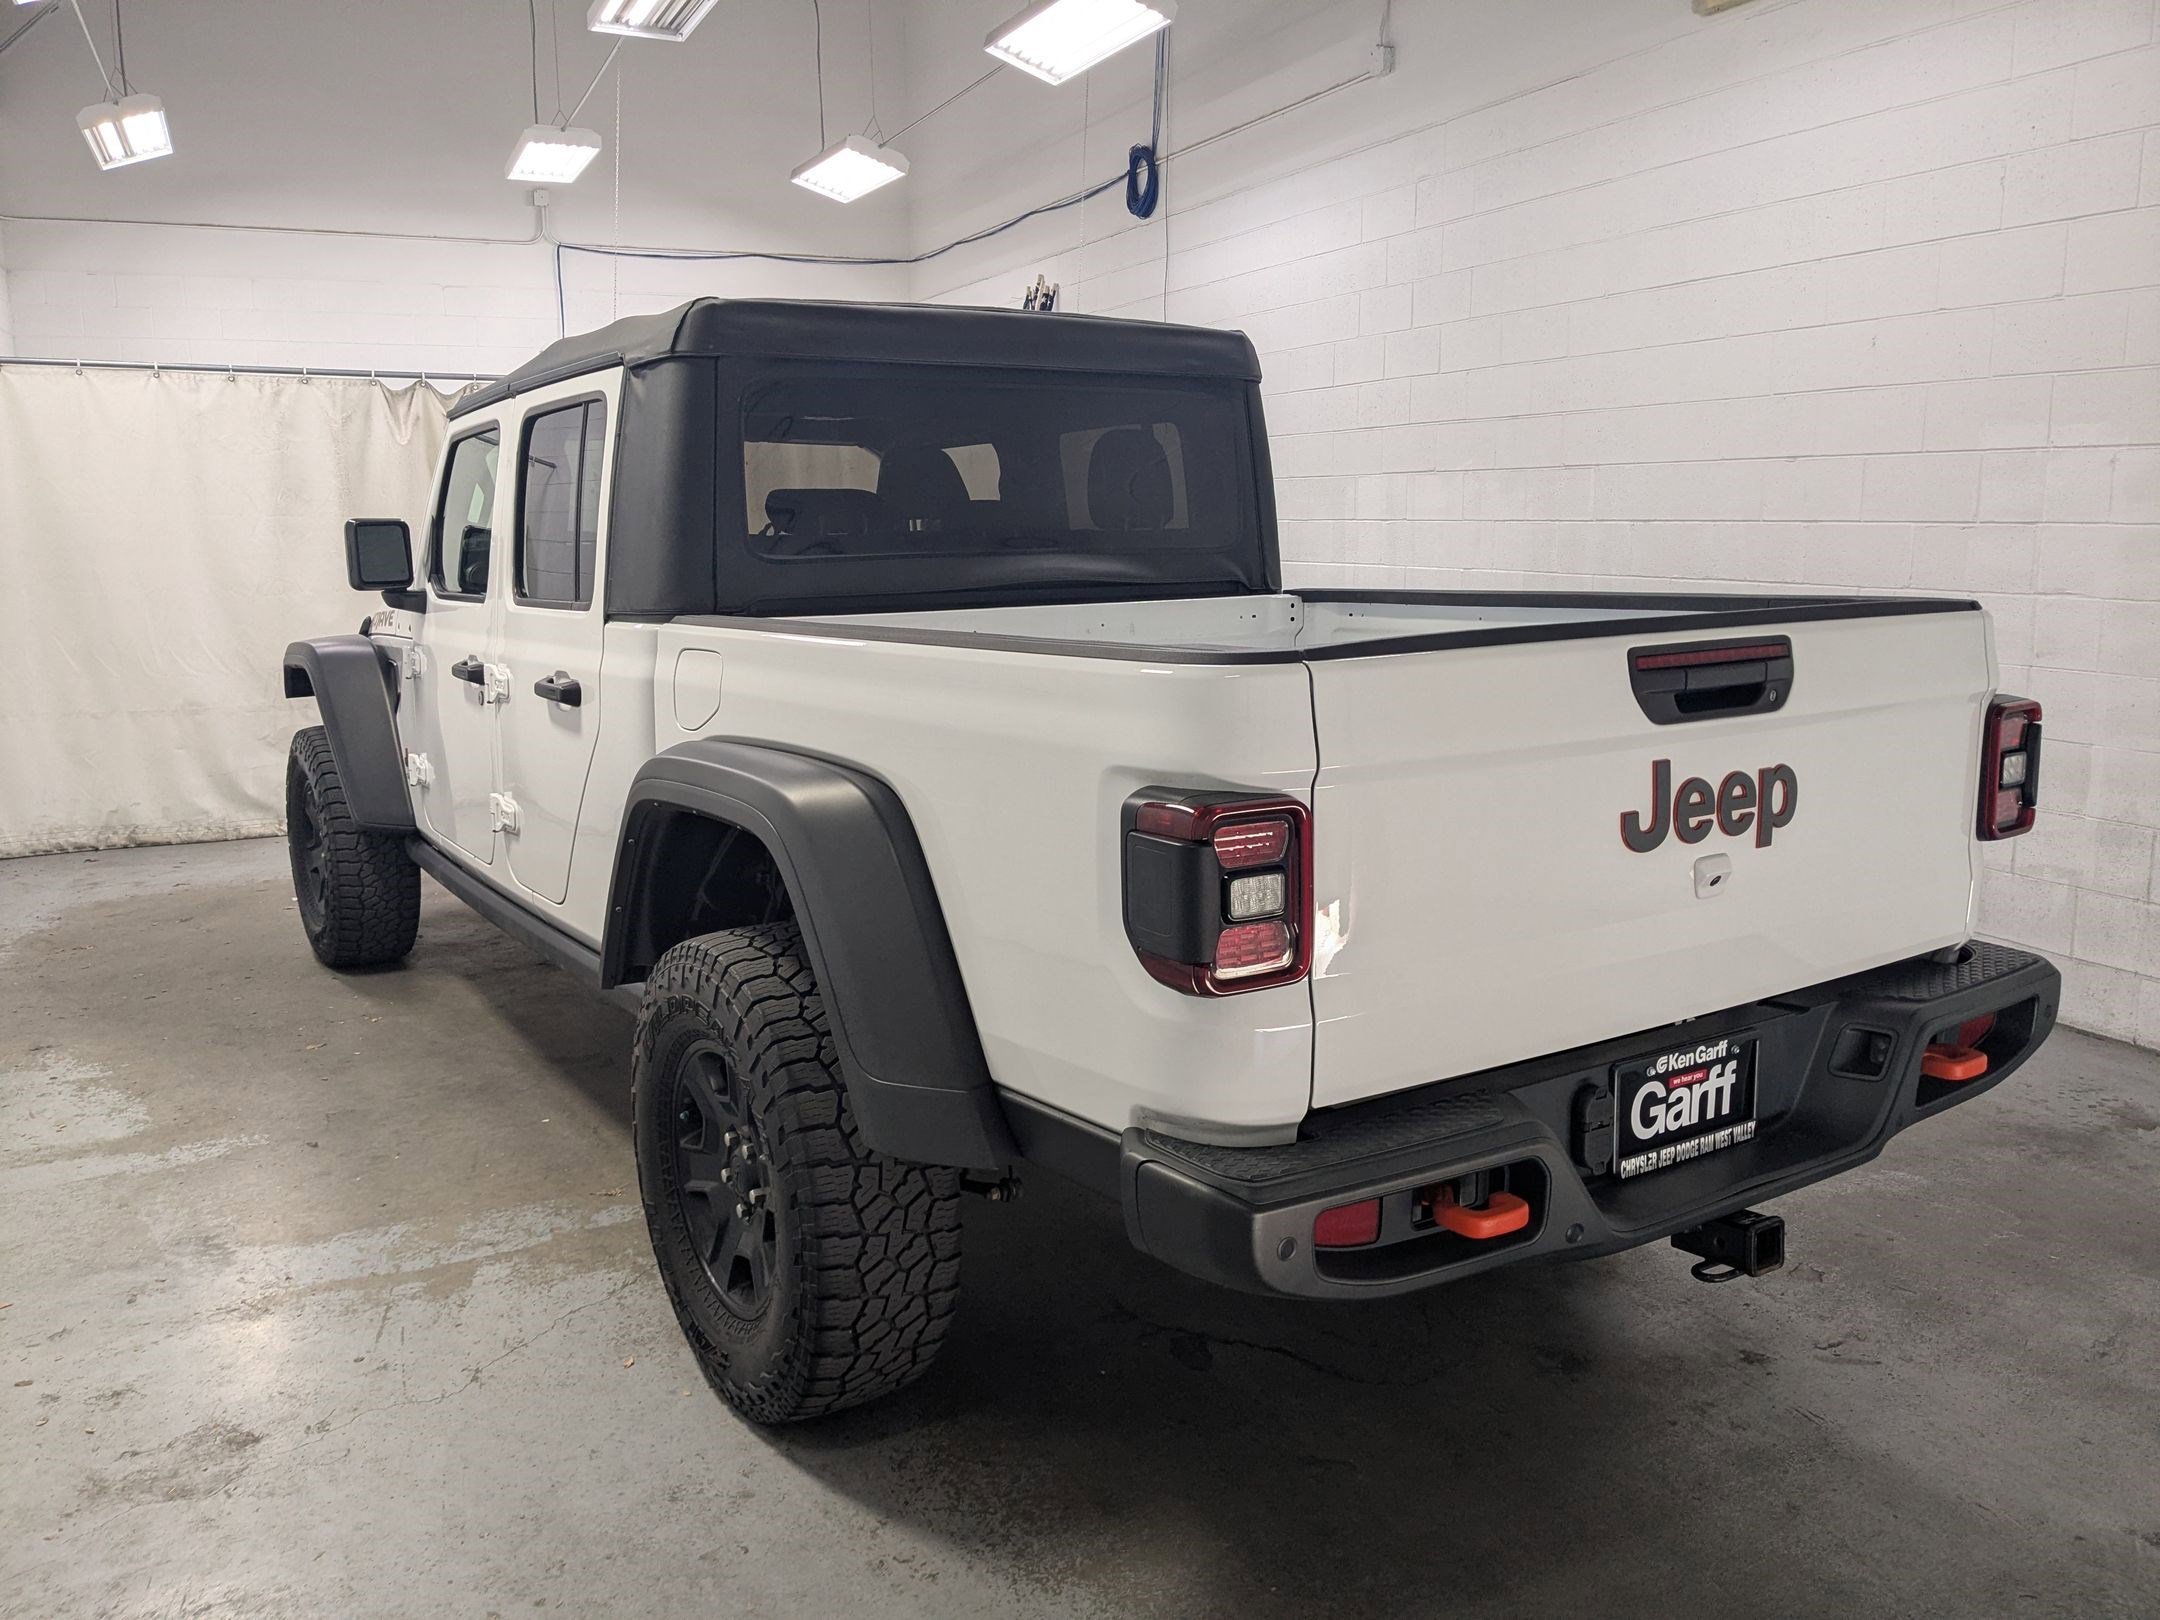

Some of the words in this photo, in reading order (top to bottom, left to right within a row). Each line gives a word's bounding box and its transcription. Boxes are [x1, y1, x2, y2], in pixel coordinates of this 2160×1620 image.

[1620, 758, 1798, 853] Jeep
[1668, 1052, 1695, 1072] Ken
[1695, 1039, 1728, 1064] Garff
[1681, 1075, 1693, 1083] hear
[1693, 1072, 1704, 1082] you
[1631, 1060, 1738, 1140] Garff
[1620, 1151, 1658, 1179] CHRYSLER
[1658, 1146, 1676, 1168] JEEP
[1676, 1139, 1699, 1162] DODGE
[1699, 1134, 1714, 1155] RAM
[1714, 1128, 1733, 1150] WEST
[1733, 1121, 1757, 1144] VALLEY
